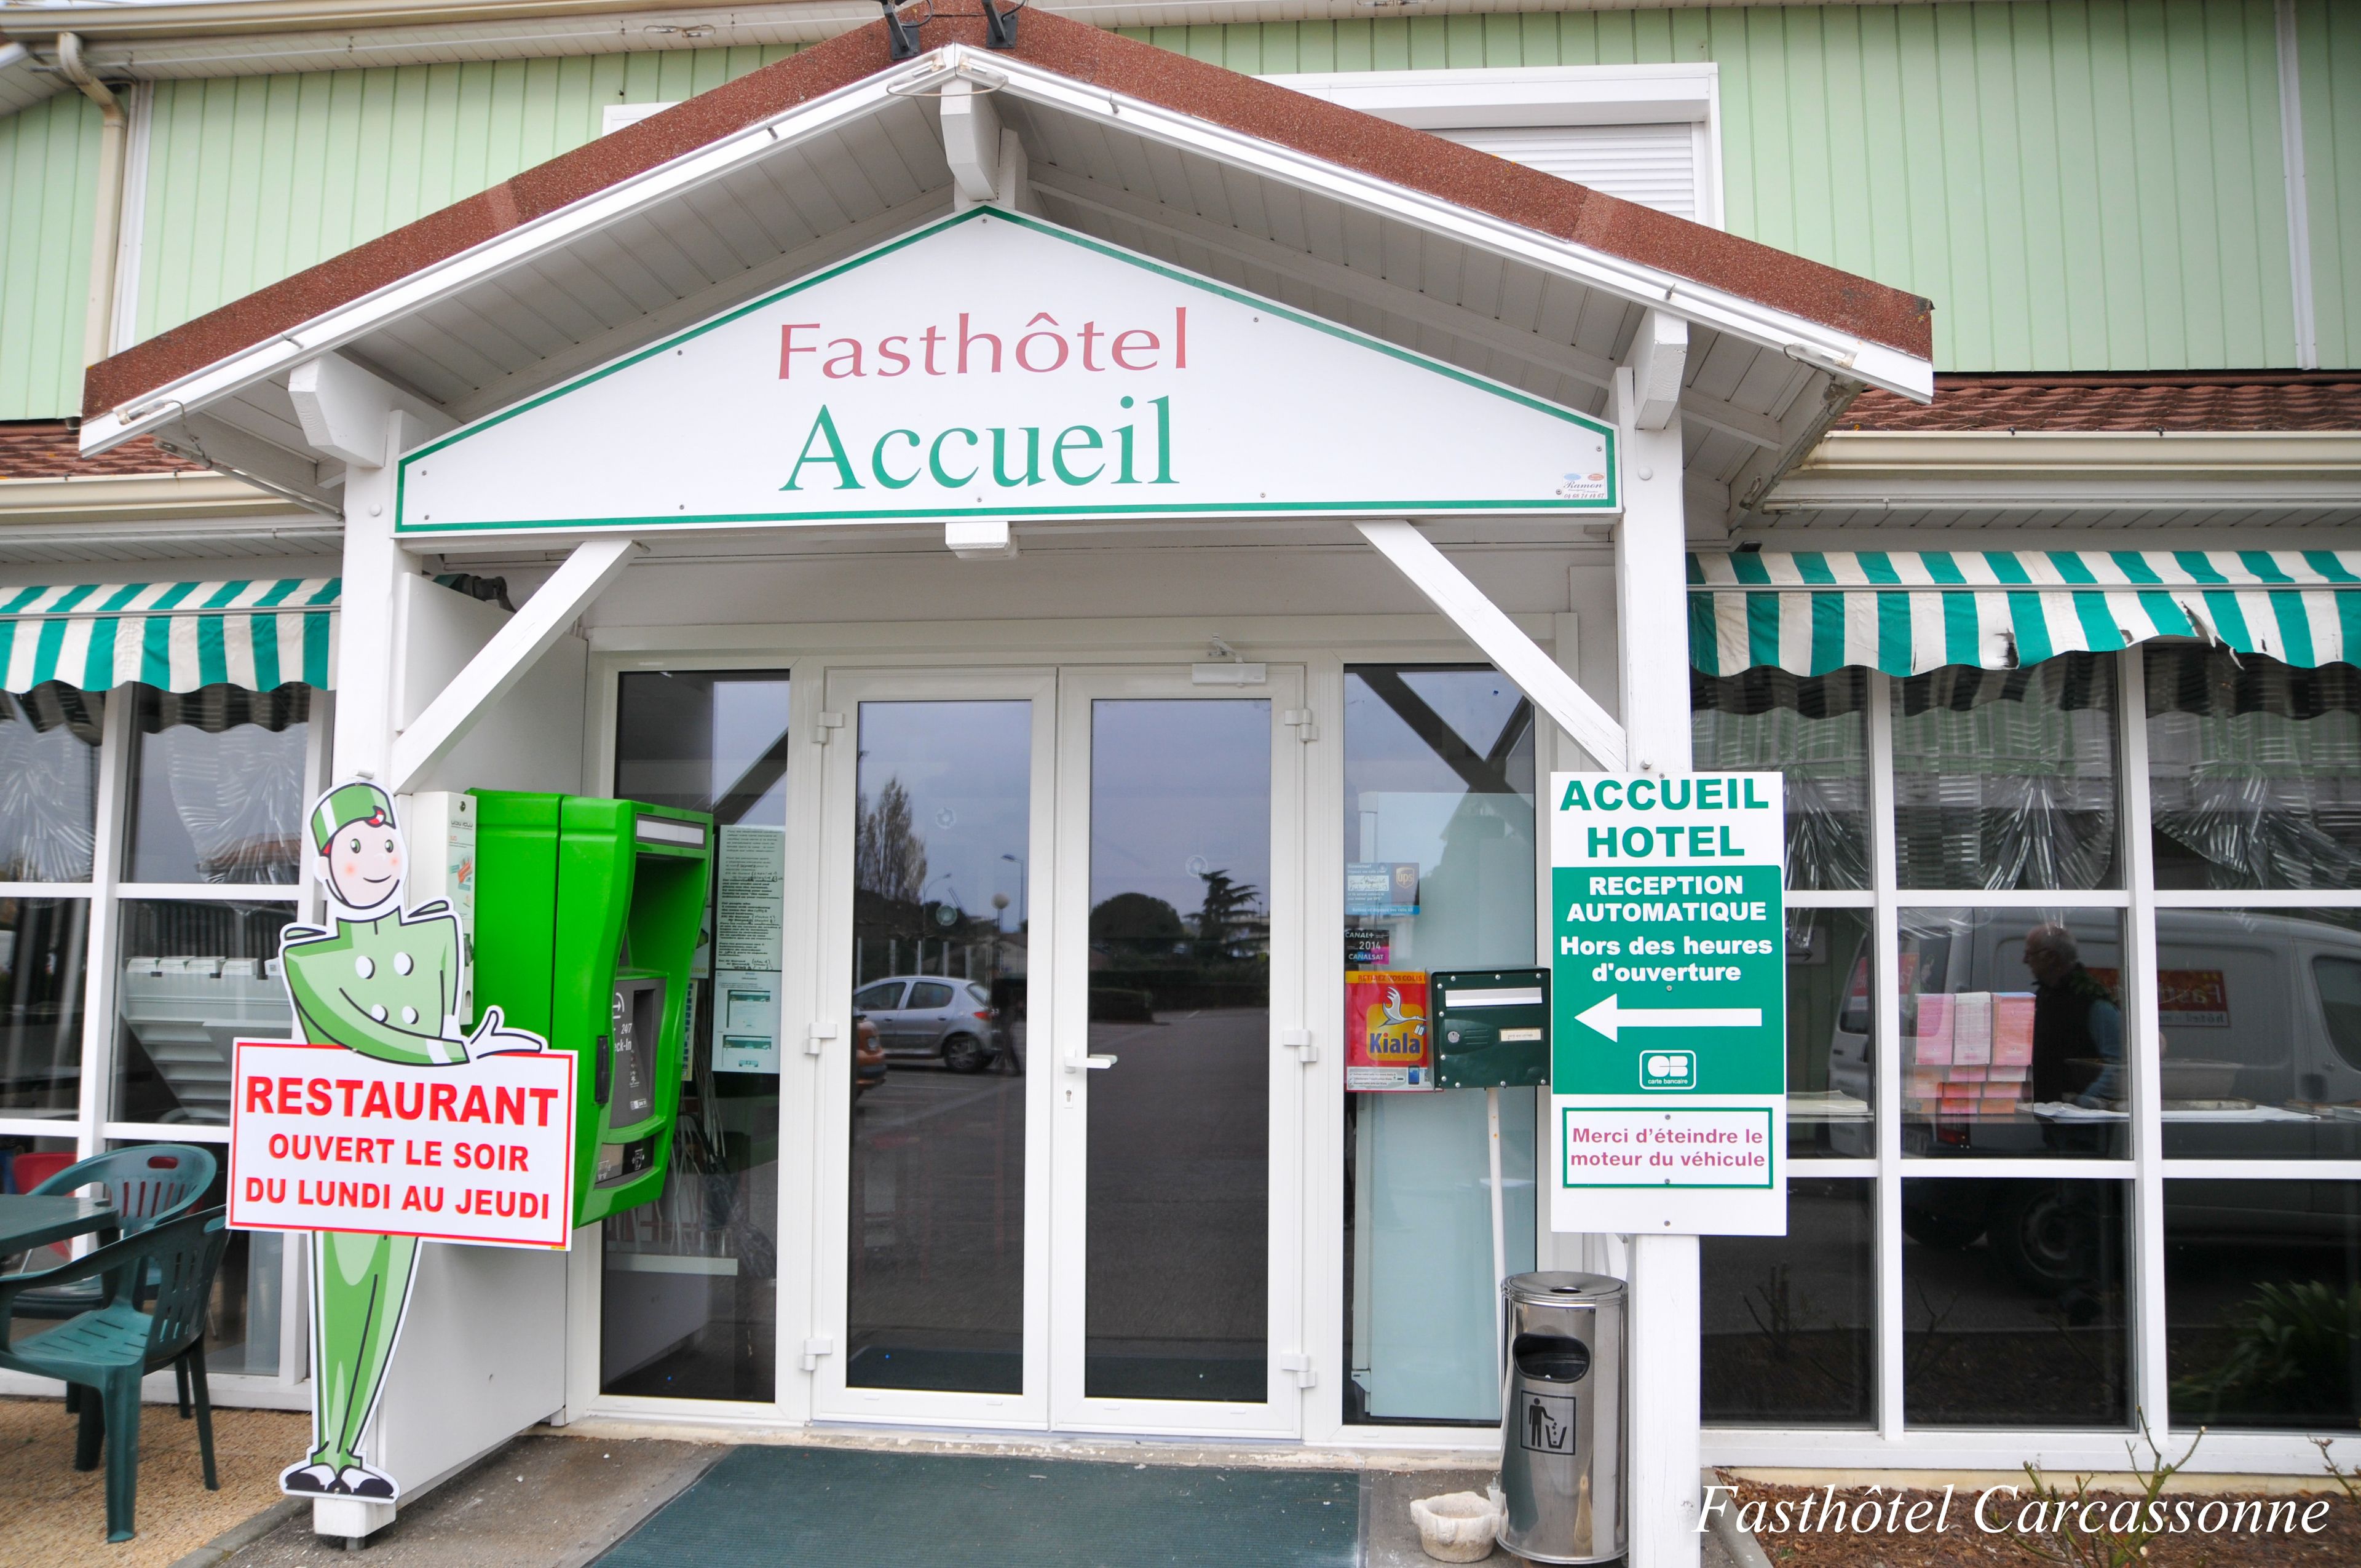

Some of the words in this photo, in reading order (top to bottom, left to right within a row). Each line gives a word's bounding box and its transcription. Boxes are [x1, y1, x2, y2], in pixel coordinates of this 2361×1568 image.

[779, 307, 1186, 379] Fasthôtel
[779, 395, 1179, 491] Accueil
[1560, 778, 1769, 811] ACCUEIL
[1588, 826, 1745, 858] HOTEL
[1398, 874, 1413, 885] ups
[1589, 876, 1742, 895] RECEPTION
[1567, 902, 1766, 922] AUTOMATIQUE
[1359, 941, 1381, 950] 2014
[1560, 936, 1620, 955] Hors
[1629, 936, 1675, 954] des
[1684, 936, 1773, 954] heures
[1592, 962, 1741, 981] d'ouverture
[620, 1023, 633, 1034] 24/7
[1369, 1032, 1420, 1054] Kiala
[245, 1075, 558, 1127] RESTAURANT
[1573, 1128, 1628, 1143] Merci
[1636, 1128, 1738, 1143] d'éteindre
[1746, 1129, 1763, 1143] le
[269, 1134, 394, 1164] OUVERT
[406, 1140, 441, 1166] LE
[453, 1142, 529, 1172] SOIR
[1571, 1152, 1642, 1166] moteur
[1650, 1151, 1673, 1166] du
[1680, 1151, 1765, 1166] véhicule
[245, 1177, 286, 1203] DU
[298, 1179, 390, 1210] LUNDI
[401, 1186, 443, 1212] AU
[455, 1189, 549, 1219] JEUDI
